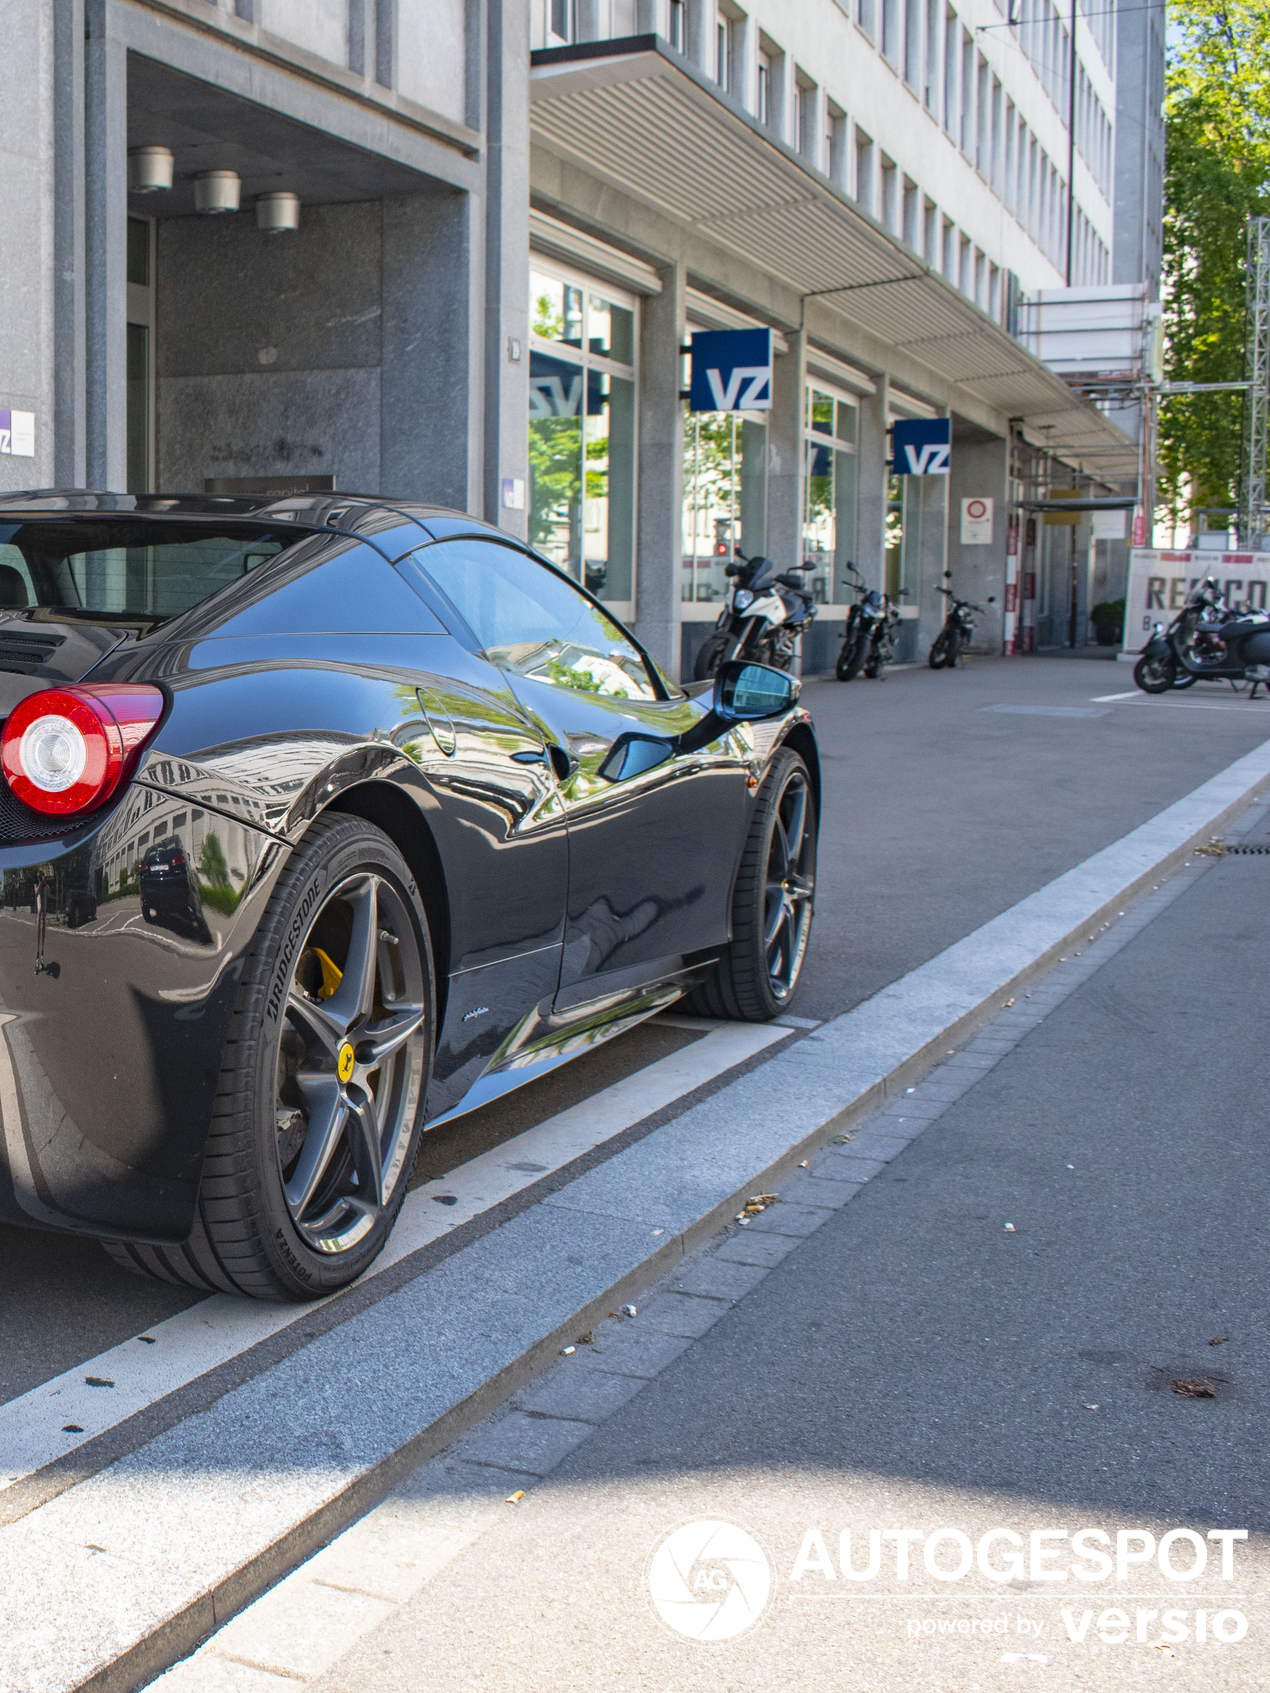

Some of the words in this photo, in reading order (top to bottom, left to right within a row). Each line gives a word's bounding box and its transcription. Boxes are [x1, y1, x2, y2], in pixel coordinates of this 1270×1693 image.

[706, 366, 771, 410] VZ
[904, 444, 951, 475] VZ
[267, 877, 321, 1023] BRIDGESTONE
[275, 1227, 312, 1282] POTENZA
